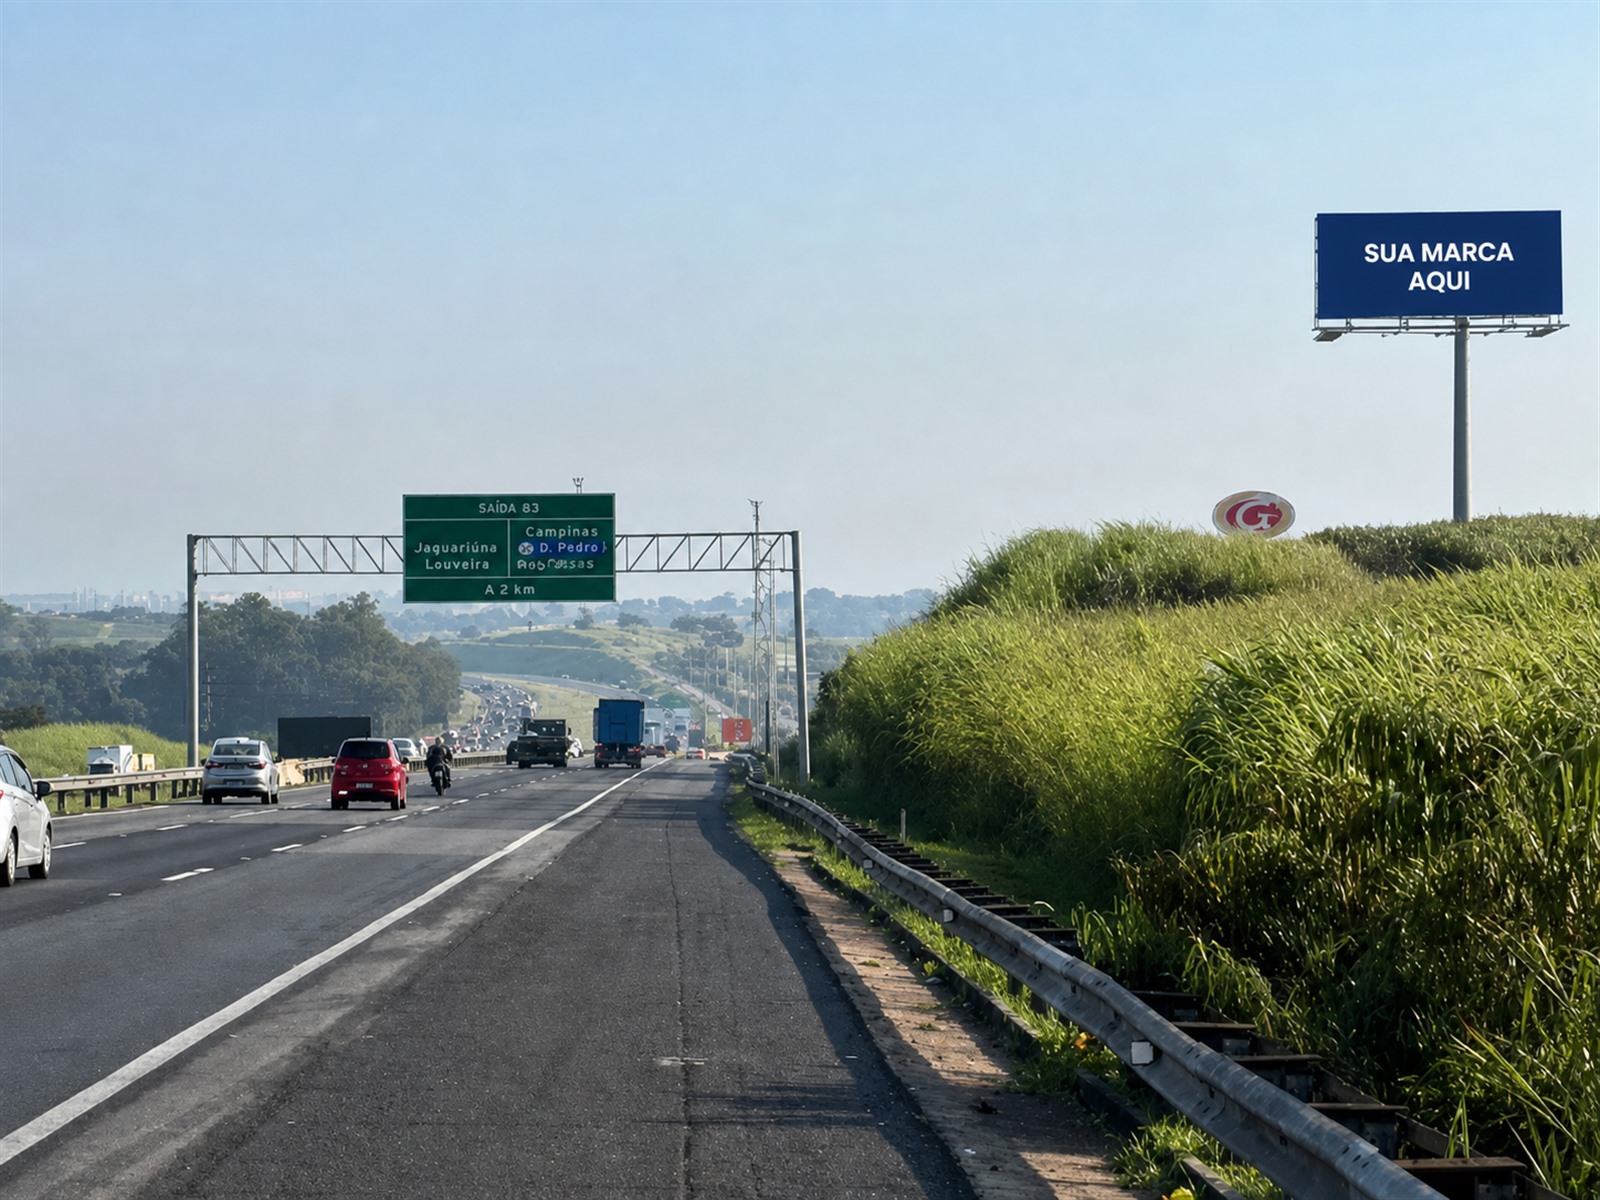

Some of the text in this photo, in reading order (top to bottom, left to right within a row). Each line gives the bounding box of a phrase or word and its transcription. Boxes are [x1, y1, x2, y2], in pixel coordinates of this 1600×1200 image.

[1363, 241, 1515, 264] SUA MARCA
[1408, 270, 1471, 294] AQUI
[478, 499, 540, 514] SAÍDA 83
[525, 525, 599, 540] Campinas
[413, 541, 498, 556] Jaguariúna
[539, 542, 553, 553] D.
[557, 541, 599, 553] Pedro
[425, 558, 490, 570] Louveira
[484, 584, 535, 595] A 2 km
